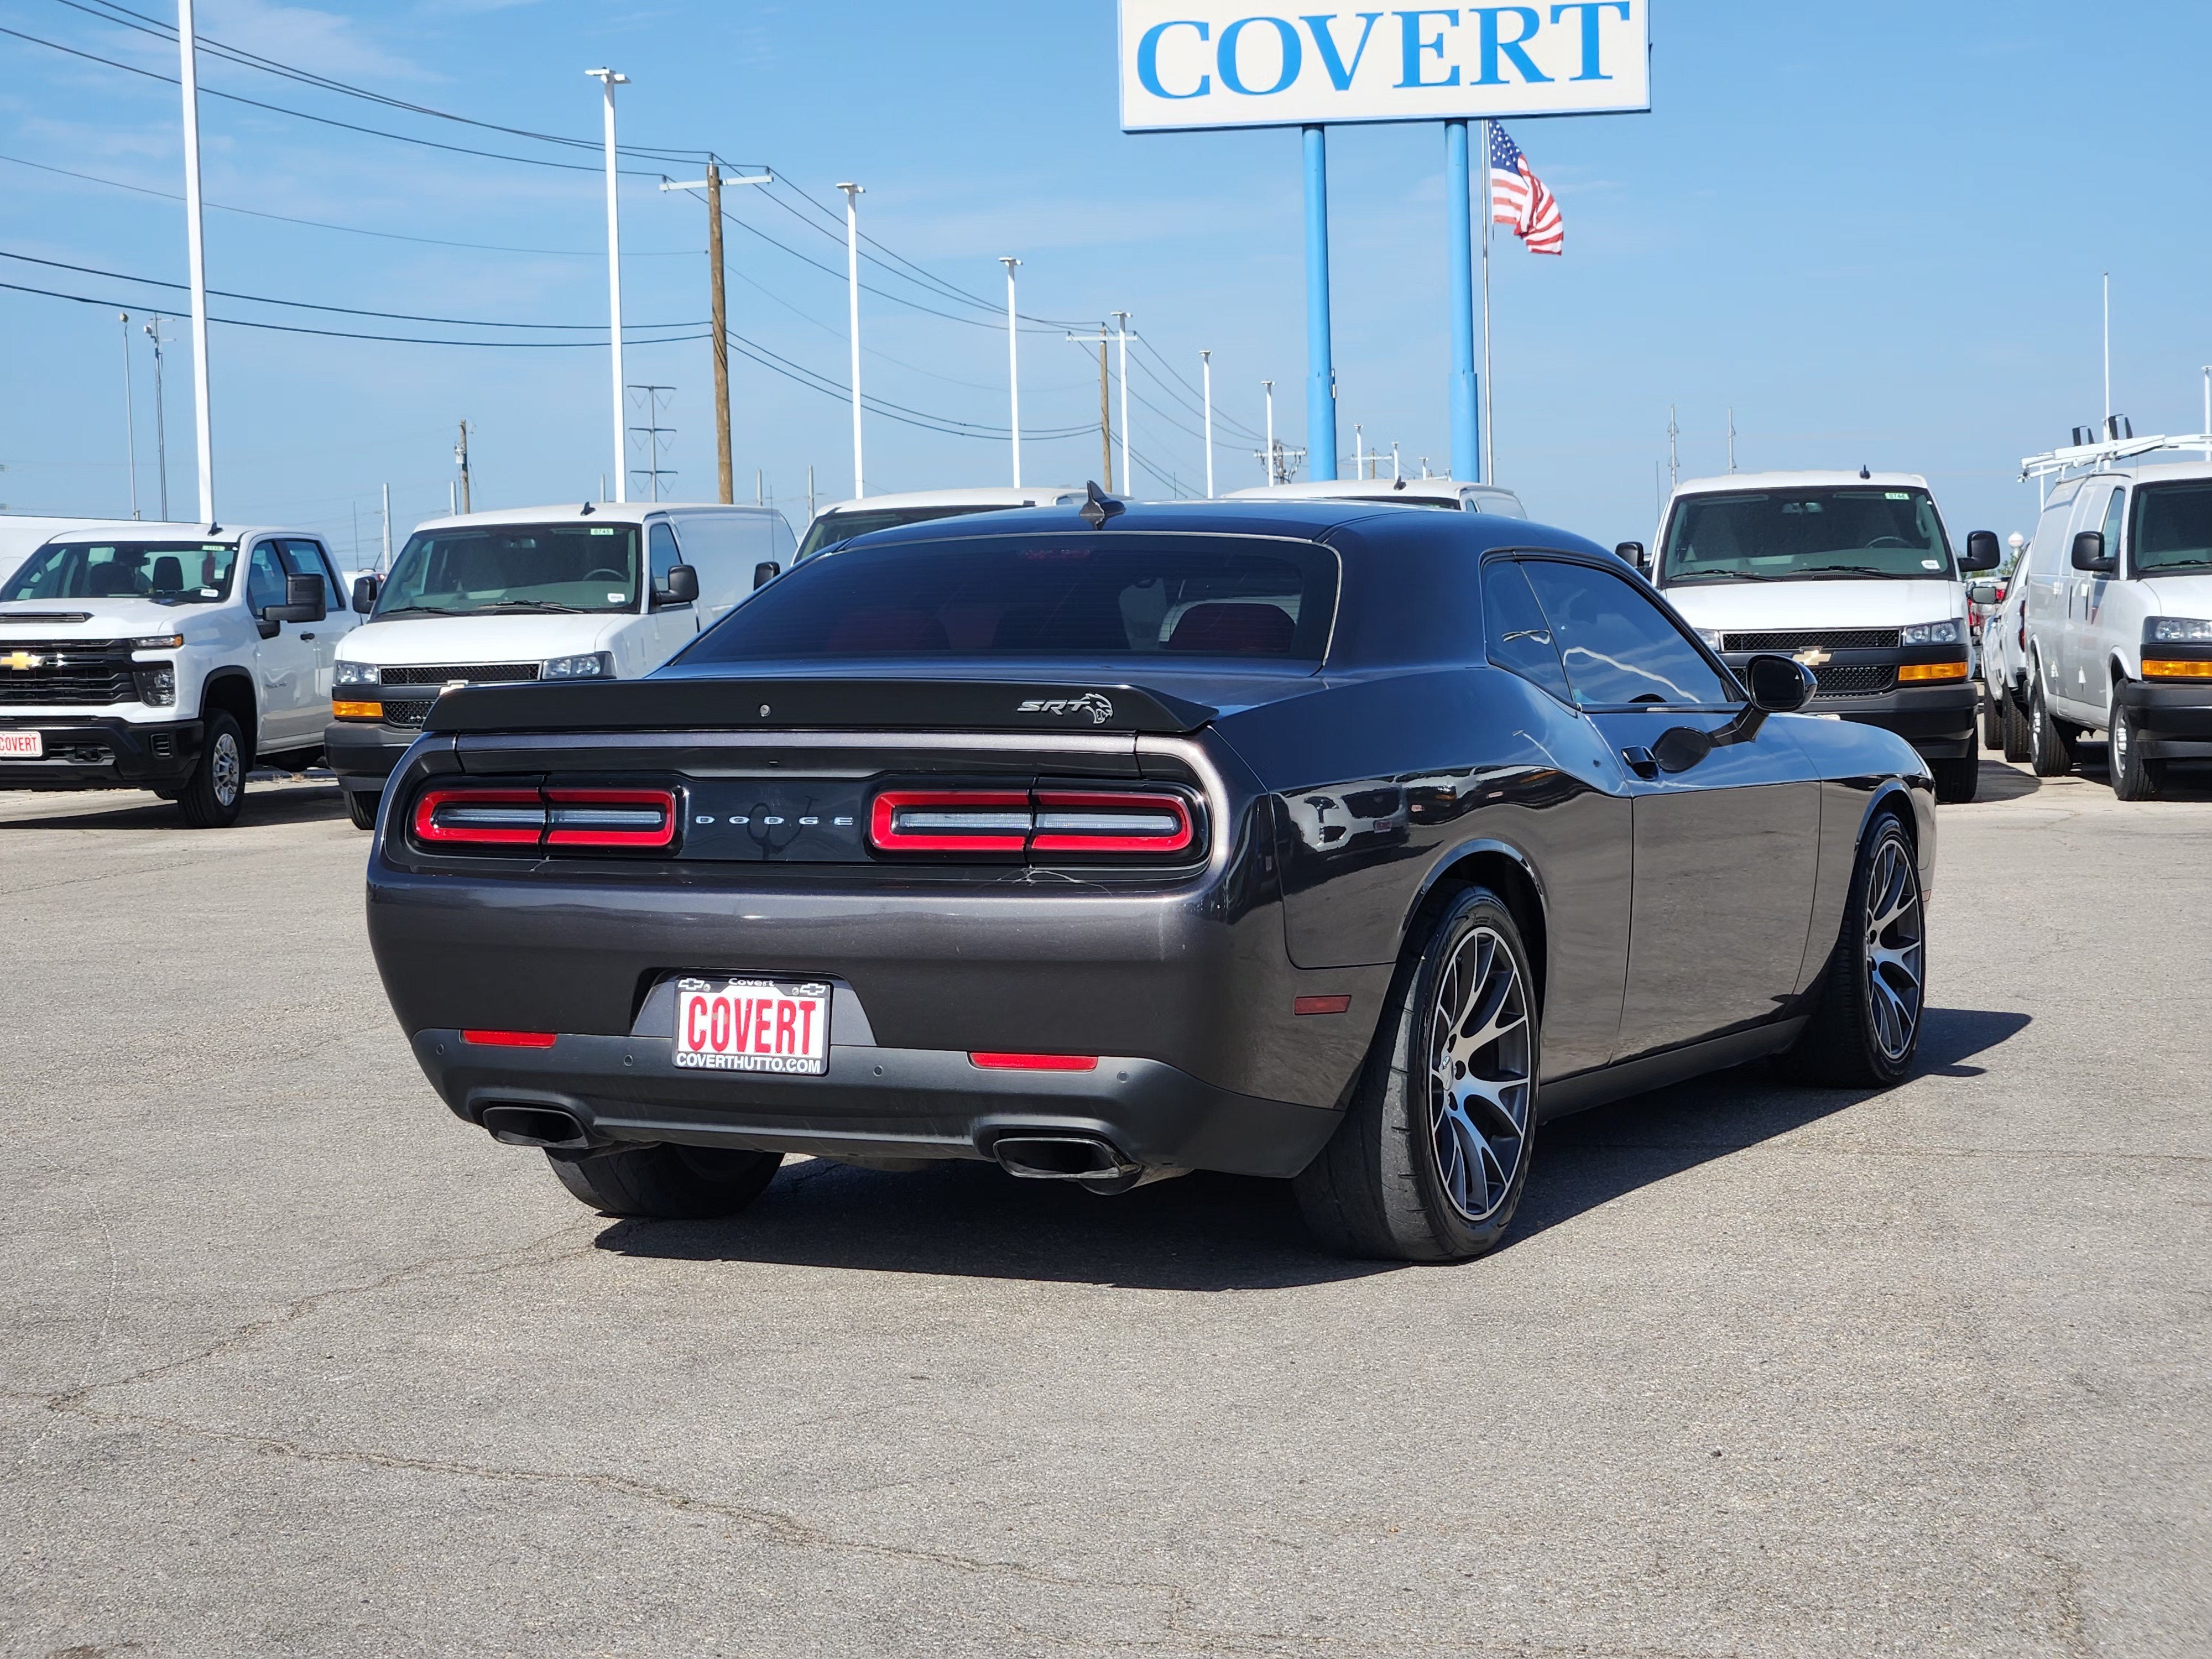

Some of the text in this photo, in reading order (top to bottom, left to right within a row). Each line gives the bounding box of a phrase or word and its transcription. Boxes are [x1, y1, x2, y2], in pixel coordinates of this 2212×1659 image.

[1136, 1, 1631, 100] COVERT
[1017, 700, 1091, 715] SRT
[0, 737, 36, 751] COVERT
[695, 816, 853, 826] DODGE
[728, 978, 774, 987] Covert
[688, 996, 817, 1055] COVERT
[676, 1052, 820, 1073] COVERTHUTTO.COM
